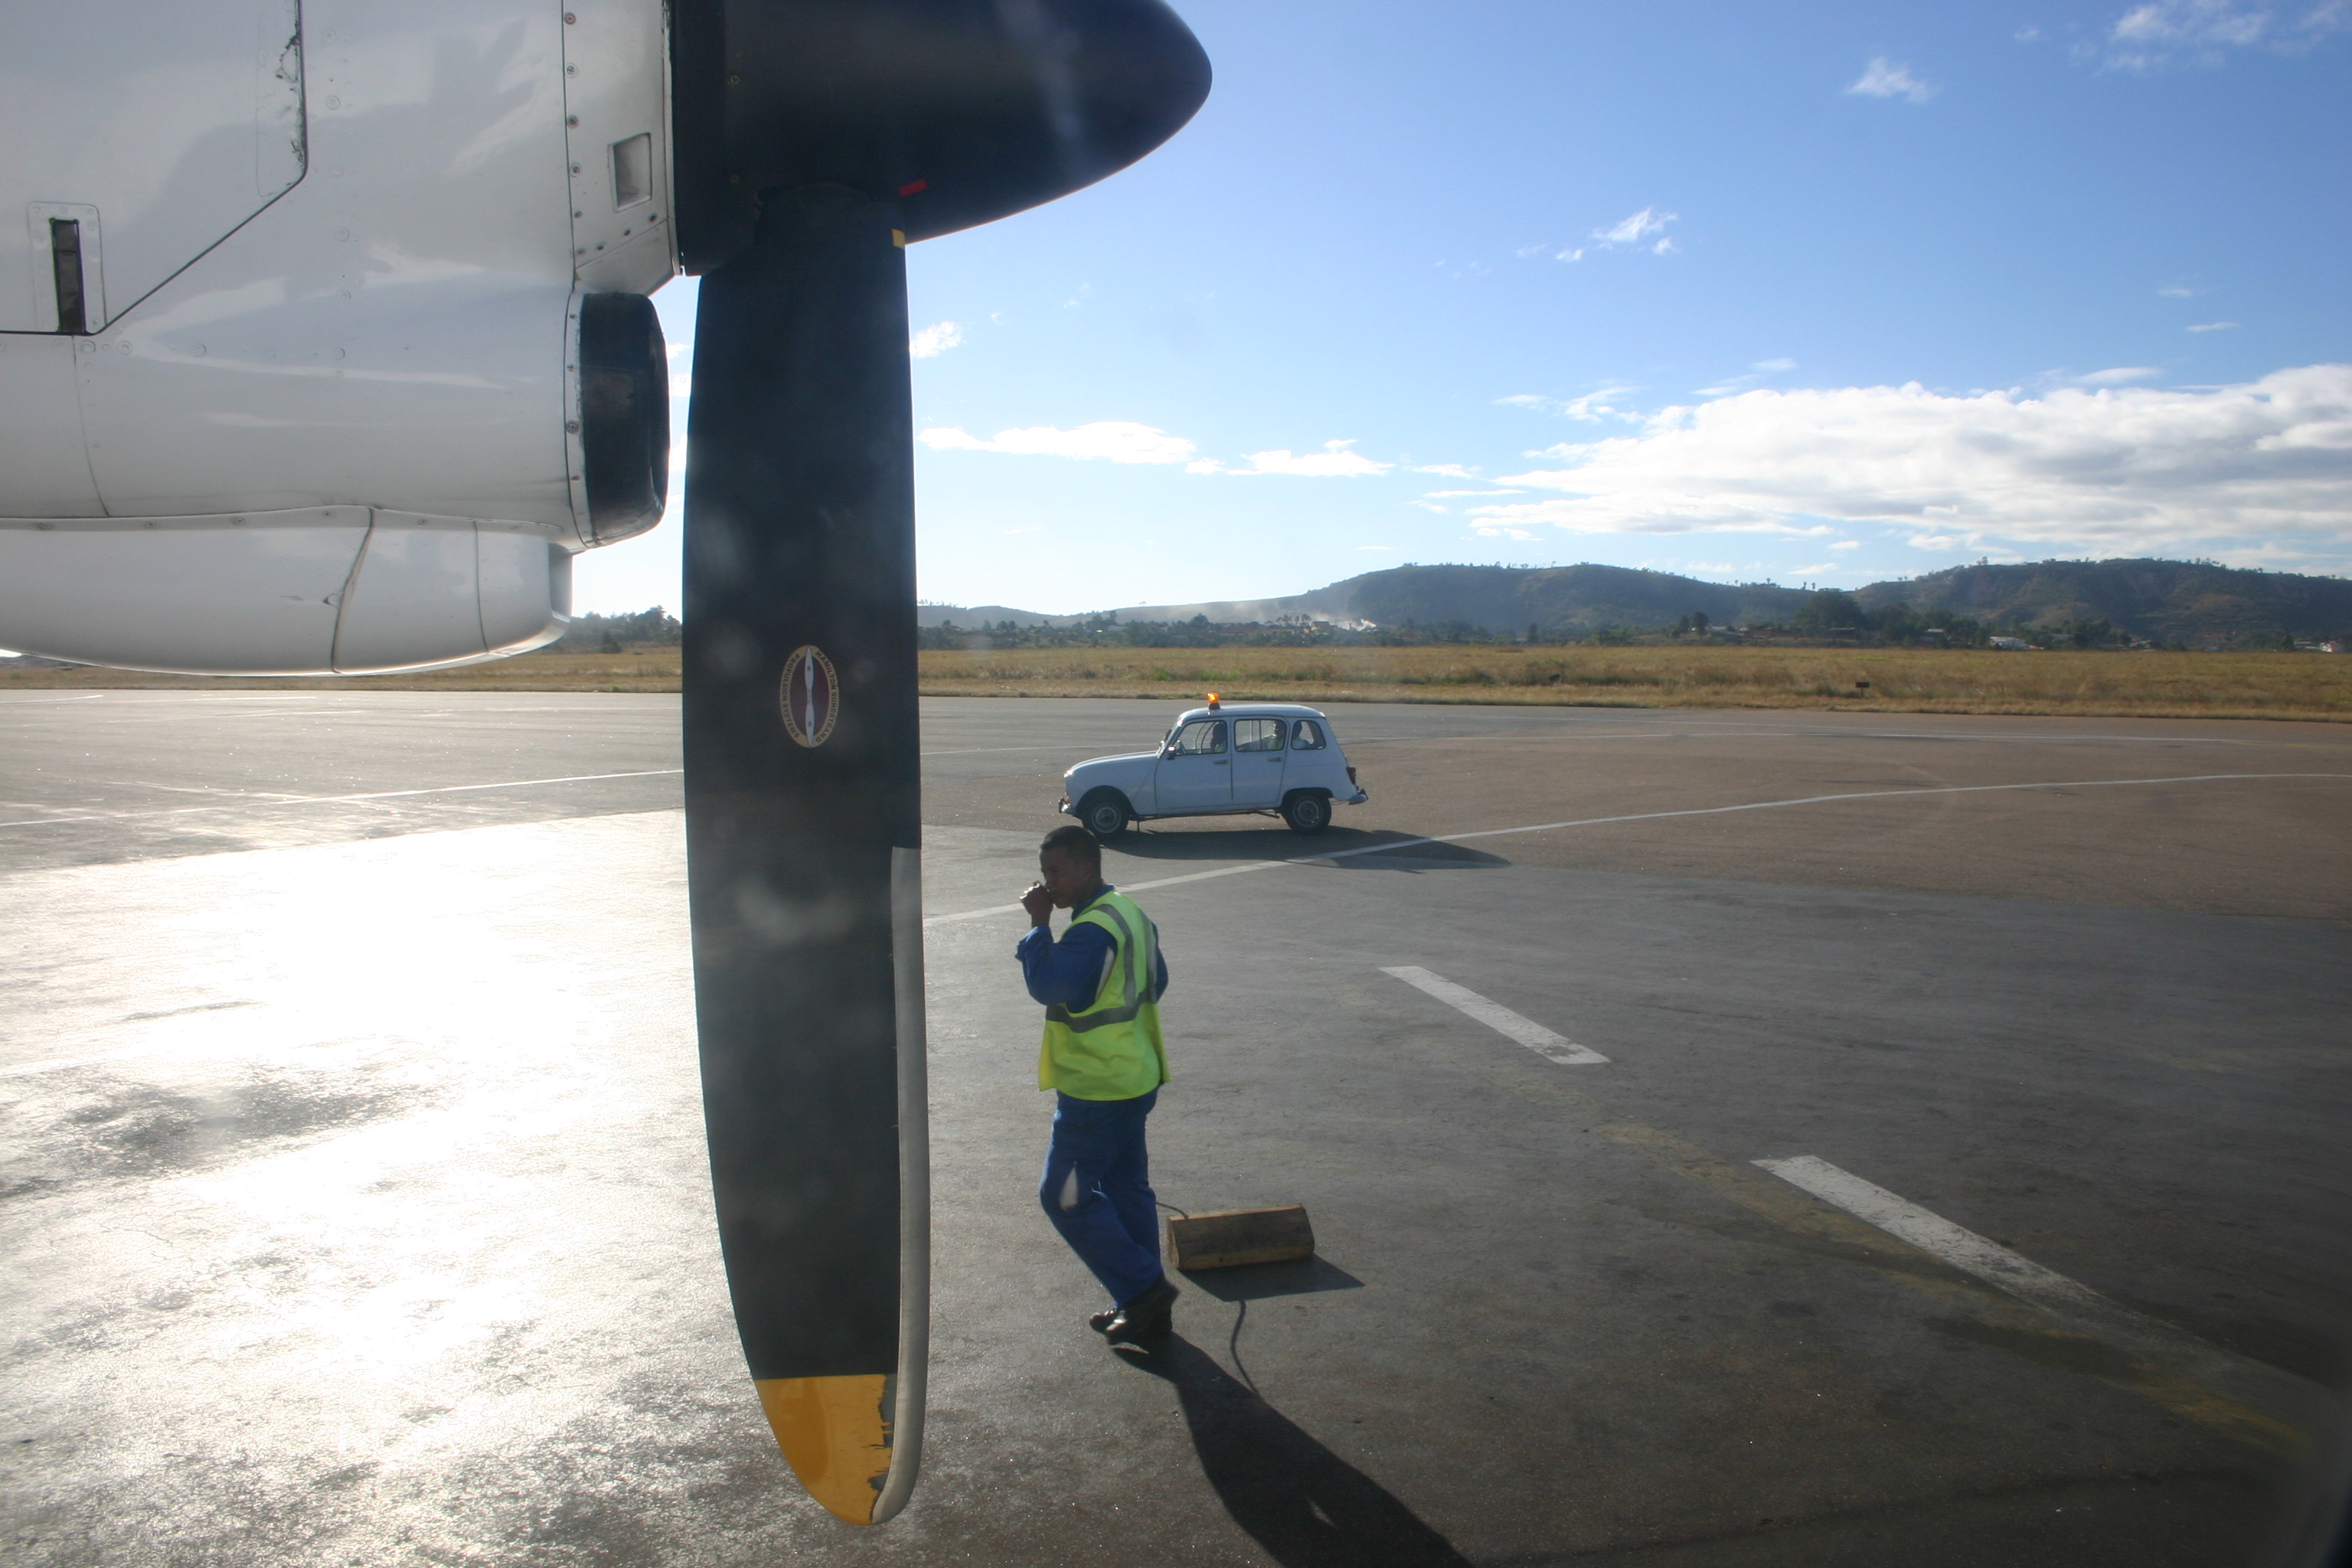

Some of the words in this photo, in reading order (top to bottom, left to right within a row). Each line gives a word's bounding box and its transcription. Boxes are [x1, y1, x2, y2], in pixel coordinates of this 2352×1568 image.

[782, 654, 800, 701] PROPULSION
[815, 651, 836, 690] HAMILTON
[782, 704, 800, 738] SYSTEMS
[815, 692, 838, 743] SUNDSTRAND
